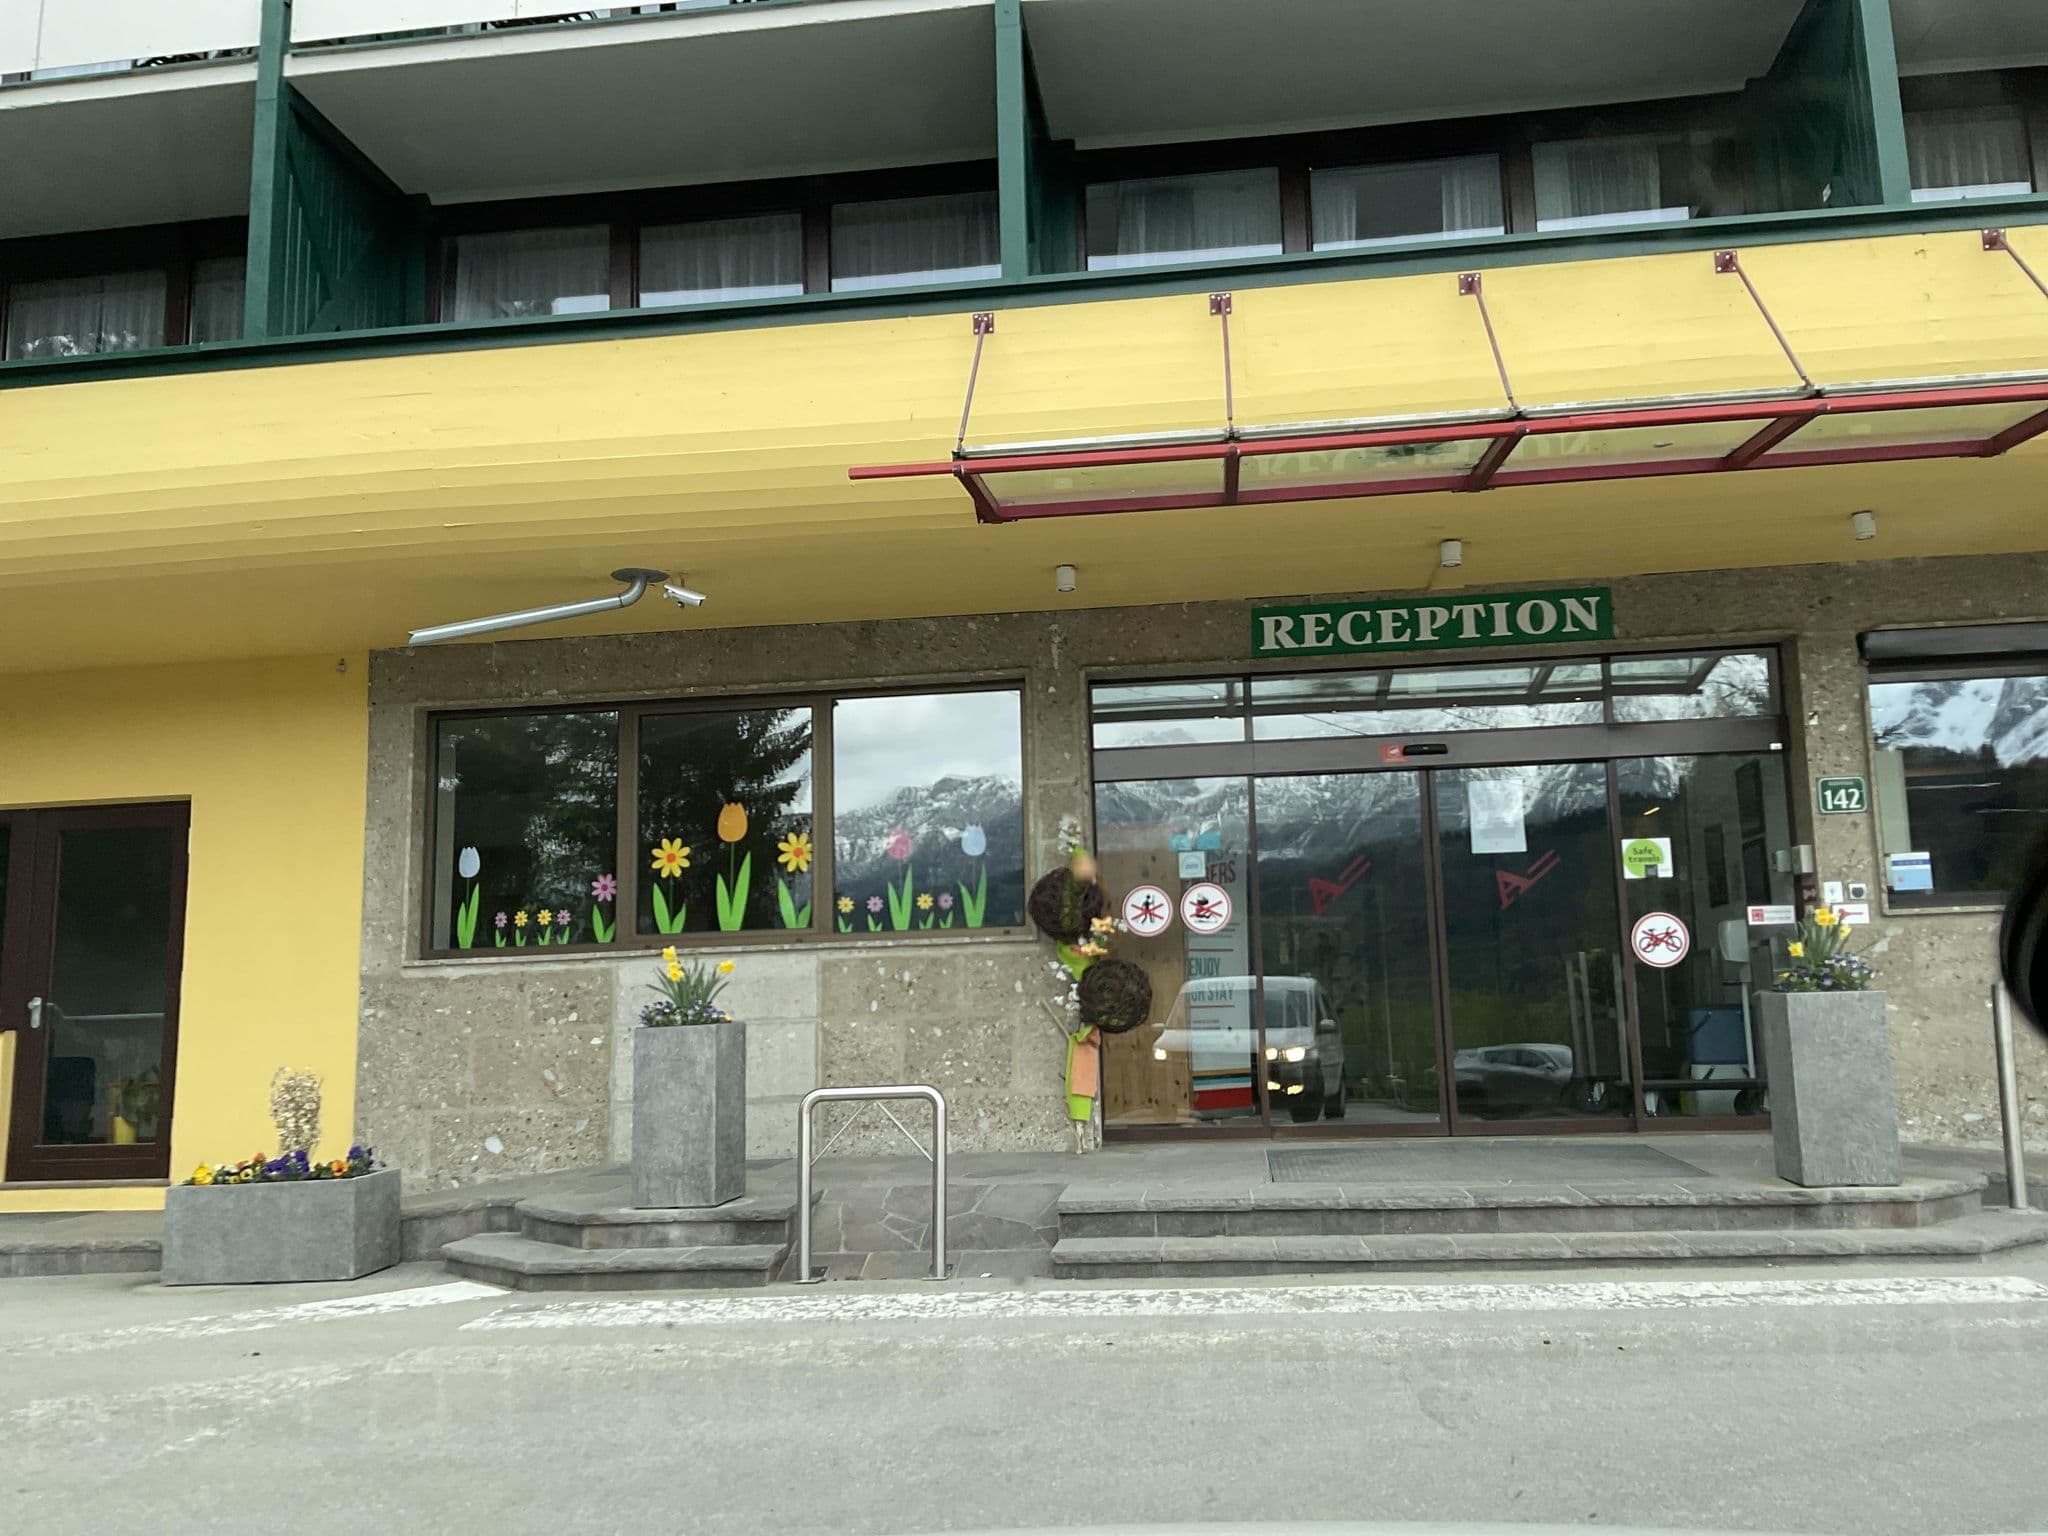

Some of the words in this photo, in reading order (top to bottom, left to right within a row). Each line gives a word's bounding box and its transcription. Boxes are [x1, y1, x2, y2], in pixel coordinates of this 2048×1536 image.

[1259, 596, 1601, 650] RECEPTION
[1824, 788, 1862, 810] 142
[1632, 846, 1653, 856] Safe
[1189, 957, 1221, 976] ENJOY
